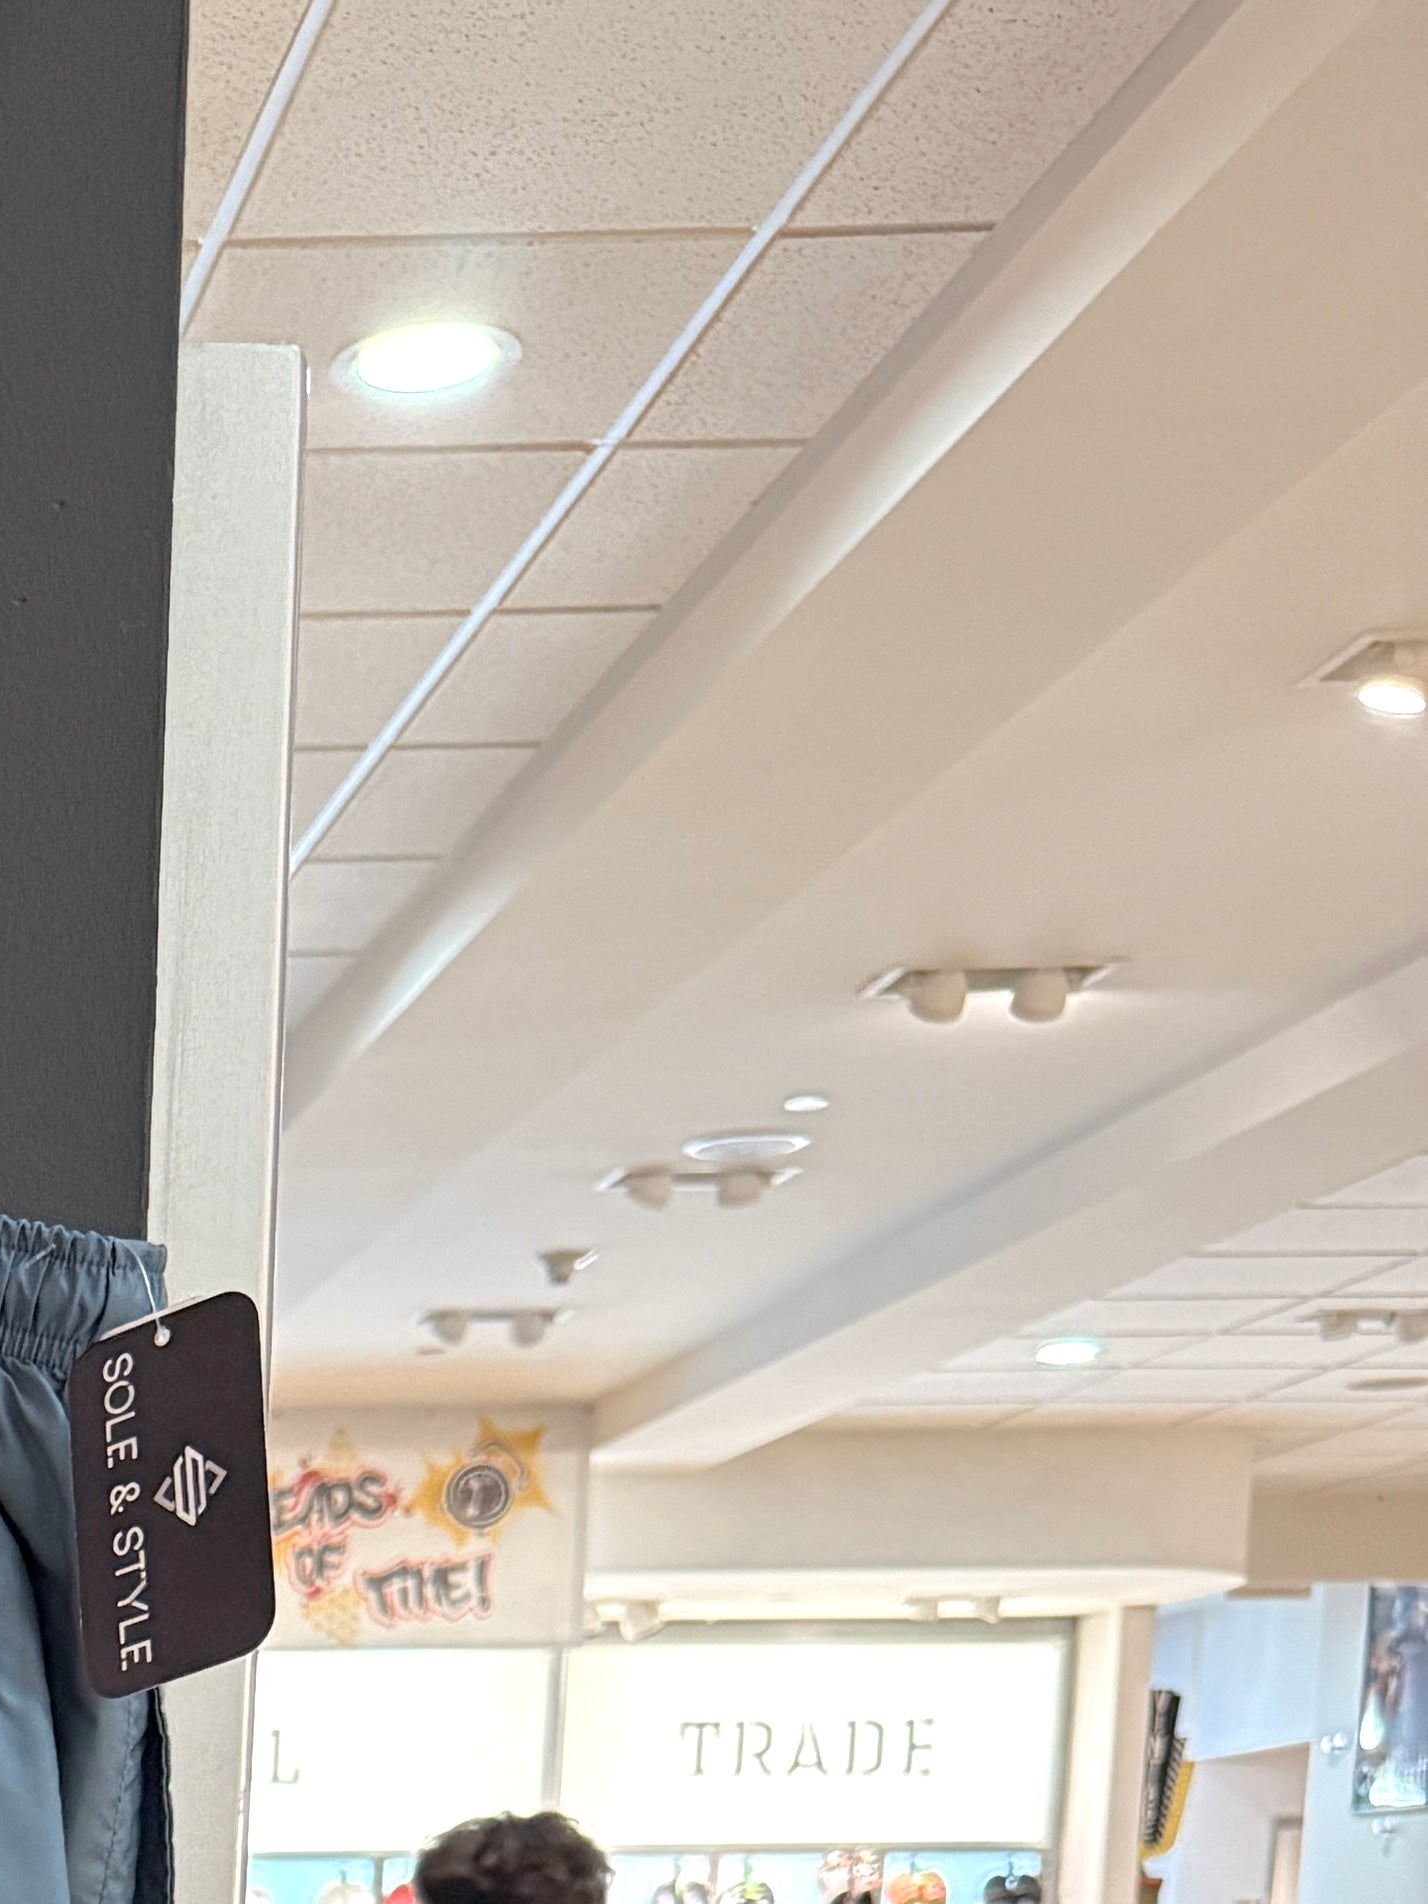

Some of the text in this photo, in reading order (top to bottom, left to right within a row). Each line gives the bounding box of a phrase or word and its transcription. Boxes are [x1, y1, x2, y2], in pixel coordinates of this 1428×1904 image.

[102, 1351, 153, 1672] SOLE & STYLE
[271, 1471, 391, 1535] EADS
[678, 1717, 935, 1777] TRADE
